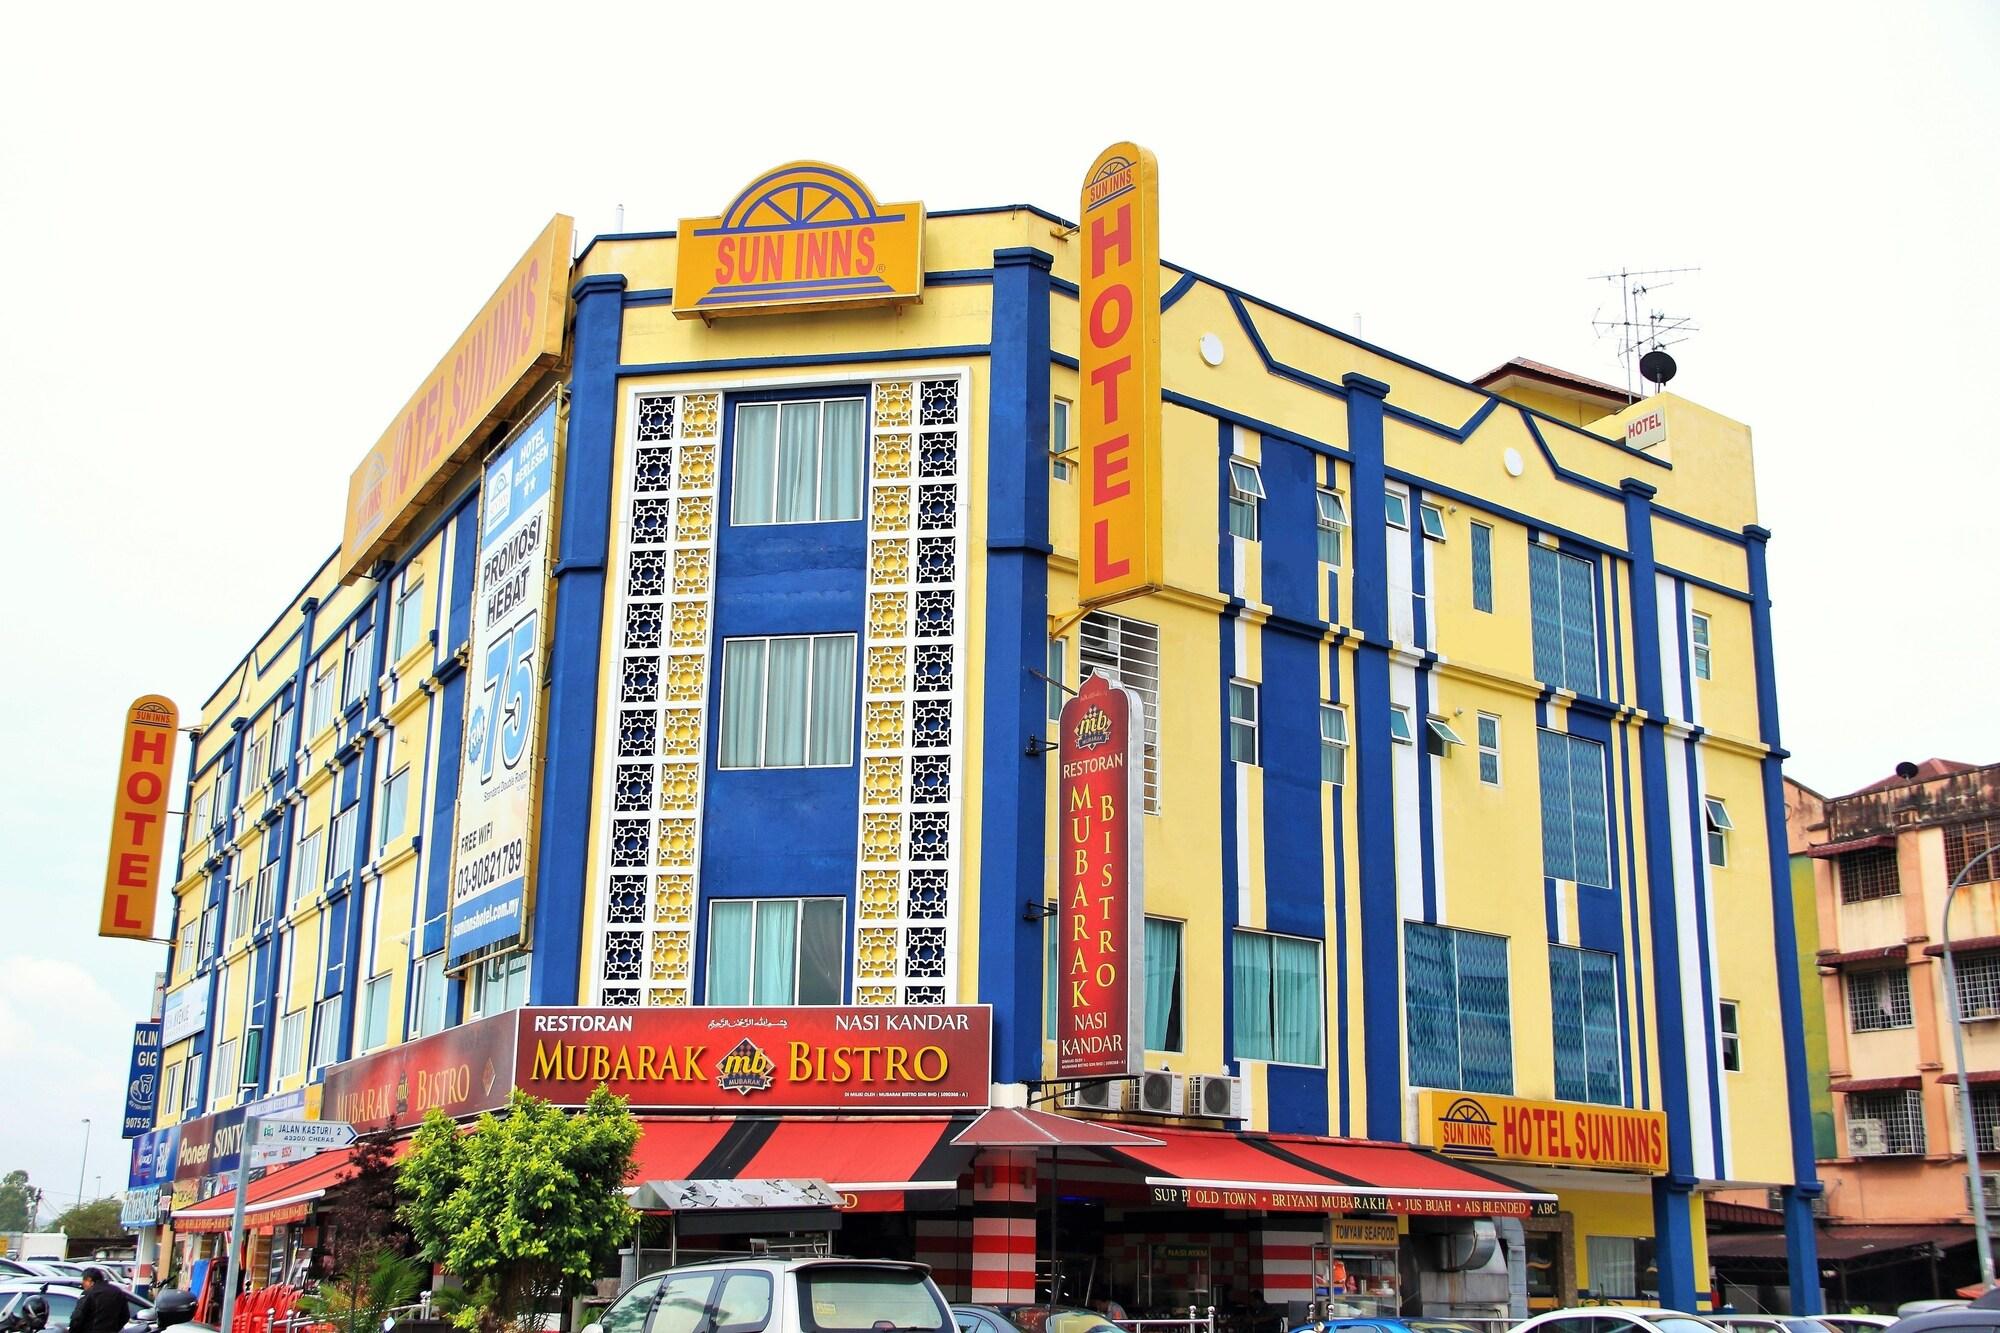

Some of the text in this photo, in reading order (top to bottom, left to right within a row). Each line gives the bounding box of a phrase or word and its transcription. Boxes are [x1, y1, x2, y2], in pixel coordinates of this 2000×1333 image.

[1090, 169, 1132, 202] SUN INNS
[715, 226, 876, 284] SUN INNS
[388, 258, 539, 509] HOTEL SUN INNS
[1090, 203, 1133, 584] HOTEL
[1628, 413, 1661, 439] HOTEL
[520, 427, 546, 465] HOTEL
[483, 514, 542, 593] PROMOSI
[487, 566, 530, 627] HEBAT
[480, 607, 538, 785] 75
[136, 710, 171, 723] SUN INNS
[1080, 710, 1107, 734] mb
[468, 722, 485, 753] RM
[1063, 752, 1123, 779] RESTORAN
[114, 729, 167, 930] HOTEL
[461, 820, 494, 856] FREE WIFI
[457, 837, 523, 900] 03-90821789
[1070, 783, 1092, 1008] MUBARAK
[1096, 795, 1117, 987] BISTRO
[534, 1015, 633, 1032] RESTORAN
[835, 1014, 969, 1031] NASI KANDAR
[1074, 1012, 1107, 1031] NASI
[530, 1039, 948, 1082] MUBARAK BISTRO
[724, 1048, 767, 1075] mb
[1062, 1034, 1123, 1056] KANDAR
[336, 1063, 471, 1124] MUBARAK BISTRO
[728, 1078, 761, 1086] MUBARAK
[213, 1123, 245, 1158] SONY
[278, 1124, 342, 1136] JALAN KASTURI 2
[1443, 1122, 1491, 1145] SUN INNS
[1503, 1106, 1662, 1165] HOTEL SUN INNS
[178, 1137, 211, 1167] Pioneer
[1154, 1188, 1557, 1215] SUP PJ OLD TOWN BRIYANI MUBARAKHA JUS BUAH AIS BLENDED ABC
[1335, 1224, 1395, 1242] TOMYAM SEAFOOD
